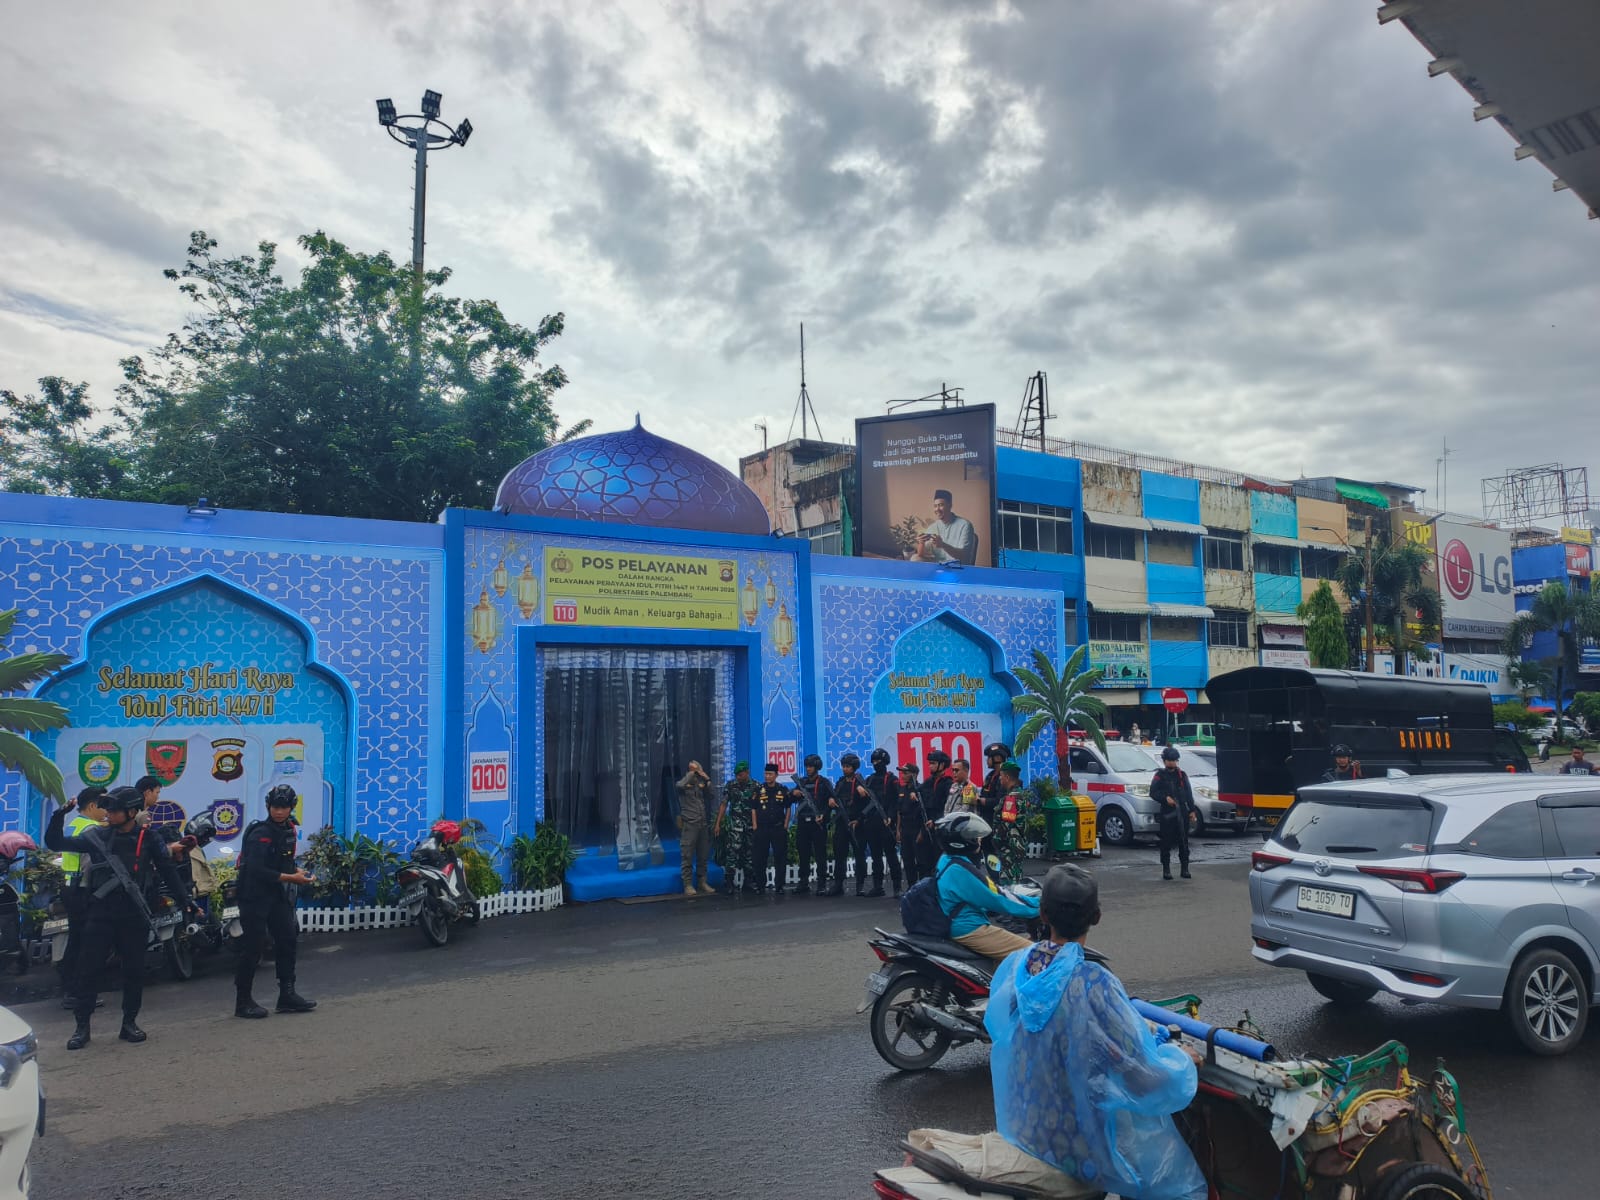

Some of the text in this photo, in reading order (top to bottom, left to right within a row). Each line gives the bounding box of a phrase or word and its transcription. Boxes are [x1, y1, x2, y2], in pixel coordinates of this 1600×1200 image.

[887, 433, 962, 447] Nunggu Buka Puasa
[883, 448, 899, 457] Jadi
[901, 447, 916, 455] Gak
[917, 445, 941, 453] Terasa
[872, 458, 912, 468] Streaming
[913, 456, 929, 464] Film
[1403, 520, 1431, 545] TOP
[581, 556, 707, 575] POS PELAYANAN
[618, 573, 674, 582] DALAM RANGKA
[1479, 553, 1511, 595] LG
[549, 577, 594, 586] PELAYANAN
[597, 580, 635, 588] PERAYAAN
[598, 588, 693, 599] POLRESTABES PALEMBANG
[556, 606, 575, 620] 110
[583, 605, 611, 617] Mudik
[614, 607, 639, 617] Aman
[647, 608, 686, 620] Keluarga
[1091, 644, 1110, 652] TOKO
[98, 662, 294, 693] Selamat Hari Raya
[889, 669, 984, 691] Selamat Hari Raya
[1460, 669, 1499, 683] DAIKIN
[119, 694, 275, 718] Idul Fitri 1447 H
[901, 691, 923, 707] Idul
[926, 692, 948, 707] Fitri
[951, 693, 968, 707] 1447
[900, 721, 979, 730] LAYANAN POLISI
[1399, 730, 1451, 749] BRIMOB
[473, 767, 506, 787] 110
[1300, 888, 1312, 901] BG
[1315, 890, 1336, 905] 1059
